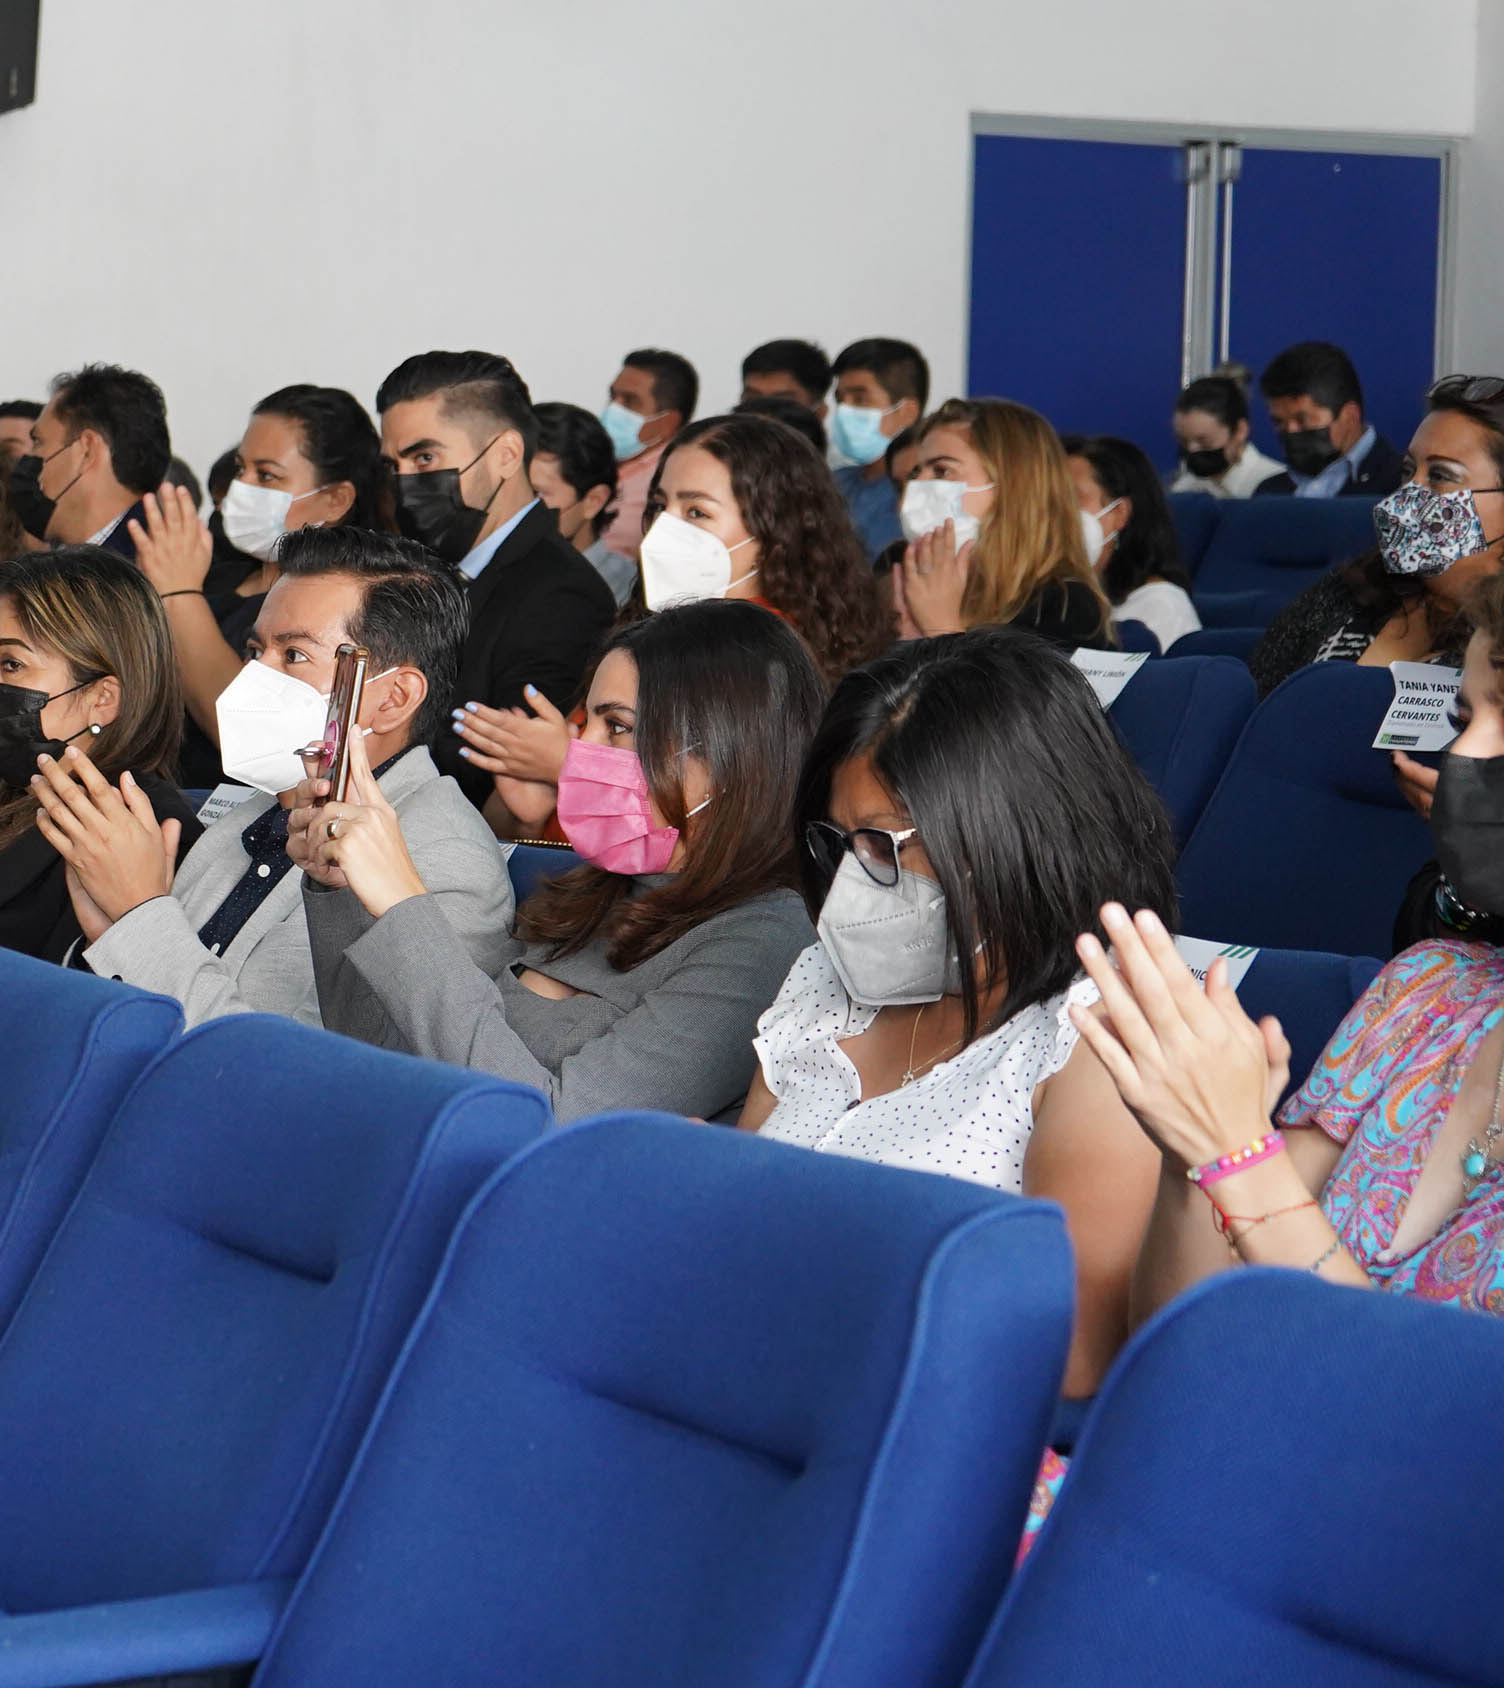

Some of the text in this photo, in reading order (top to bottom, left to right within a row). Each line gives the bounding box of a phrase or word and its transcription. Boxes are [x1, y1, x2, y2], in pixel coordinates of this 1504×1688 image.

[1399, 680, 1429, 692] TANIA
[1397, 695, 1445, 708] CARRASCO
[1391, 709, 1441, 722] CERVANTES
